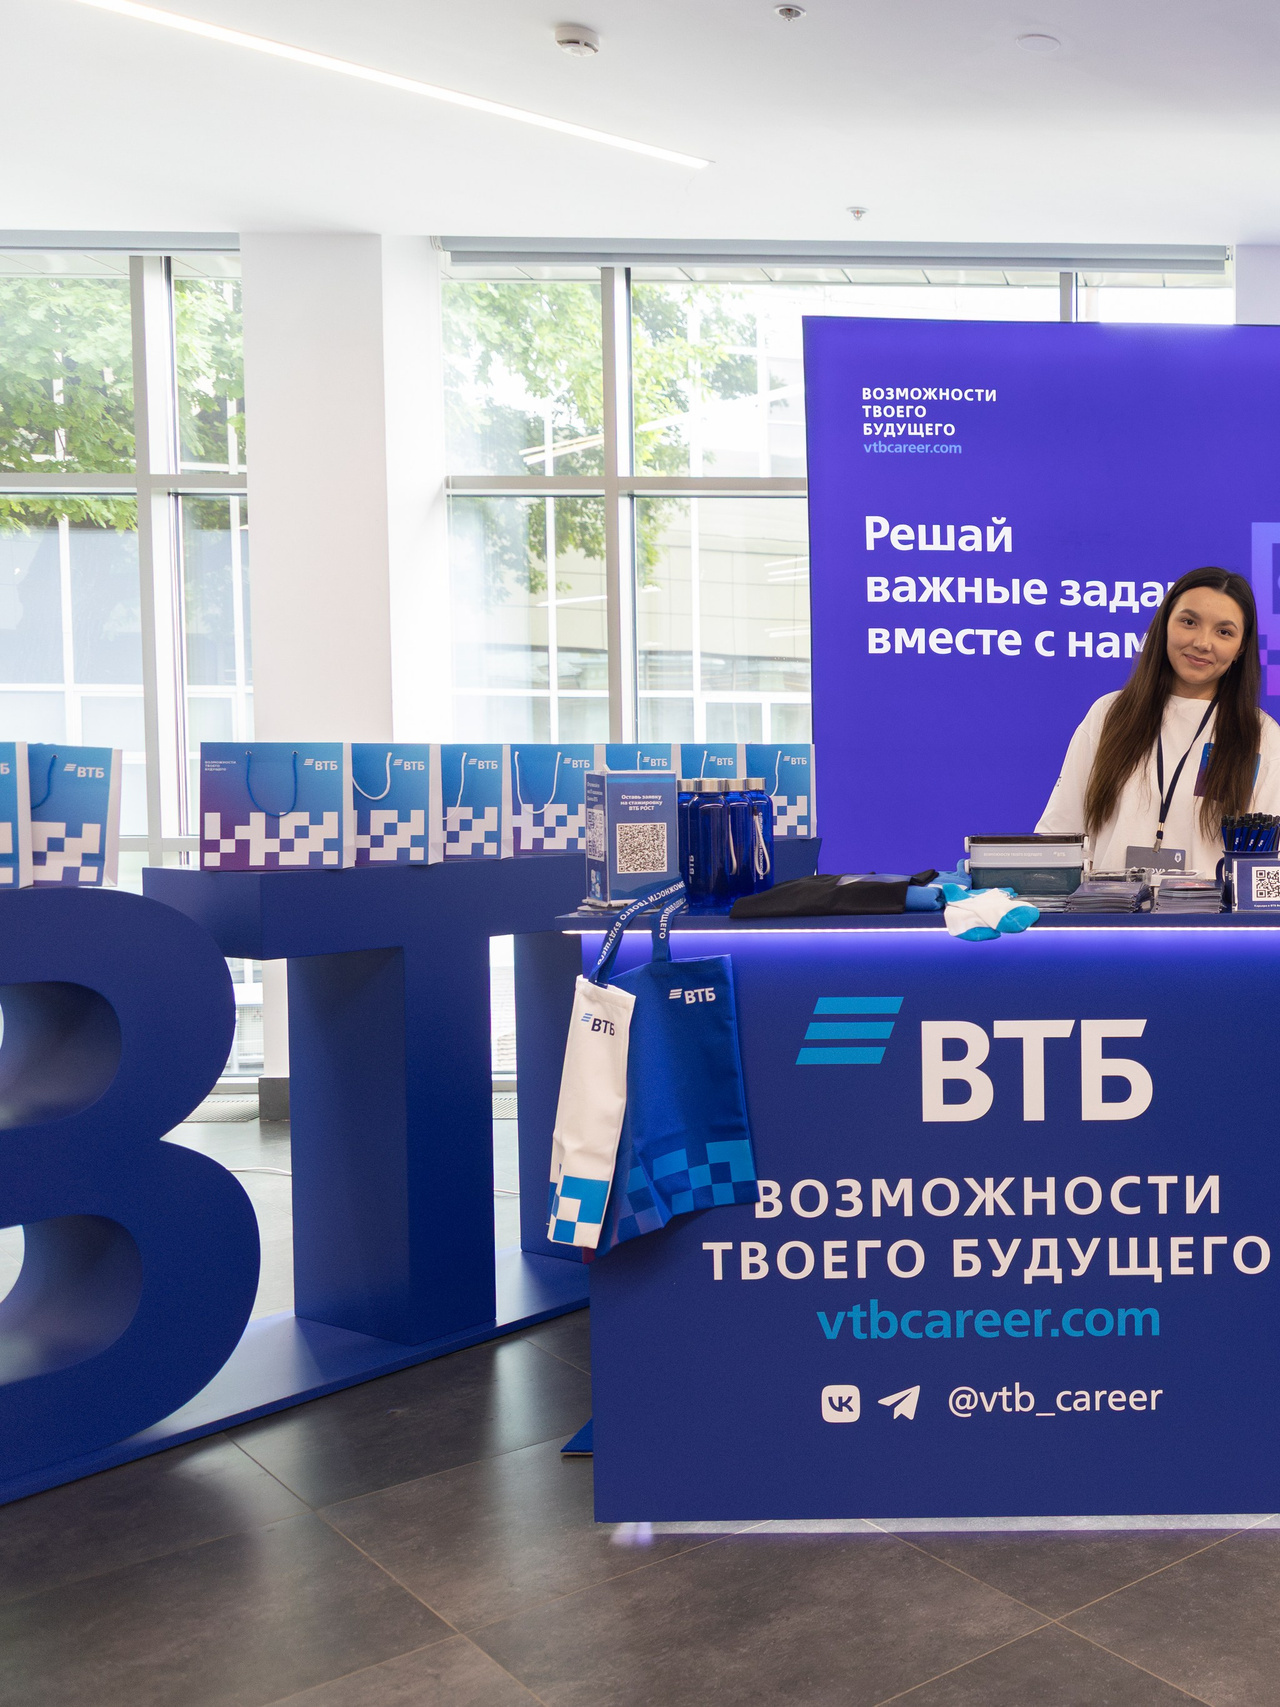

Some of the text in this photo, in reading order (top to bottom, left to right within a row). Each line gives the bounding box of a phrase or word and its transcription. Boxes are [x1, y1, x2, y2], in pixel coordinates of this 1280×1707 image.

[863, 388, 996, 401] ВОЗМОЖНОСТИ
[862, 406, 926, 417] ТВОЕГО
[864, 423, 955, 437] БУДУЩЕГО
[864, 440, 962, 453] vtbcareer.com
[866, 516, 1012, 552] Решай
[867, 576, 1175, 613] важные зада
[868, 628, 1148, 658] вместе с нам
[78, 767, 104, 778] ВТБ
[315, 761, 338, 770] ВТБ
[404, 761, 425, 770] ВТБ
[478, 761, 498, 769] ВТБ
[572, 760, 590, 768] ВТБ
[598, 880, 685, 965] МОЖНОСТИ ТВОЕГО БУДУЩЕГО
[684, 988, 716, 1004] ВТБ
[592, 1018, 614, 1036] ВТБ
[922, 1020, 1152, 1122] ВТБ
[755, 1174, 1222, 1219] ВОЗМОЖНОСТИ
[703, 1236, 1270, 1284] ТВОЕГО БУДУЩЕГО
[817, 1299, 1159, 1339] vtbcareer.com
[949, 1382, 1162, 1417] @vtb_career
